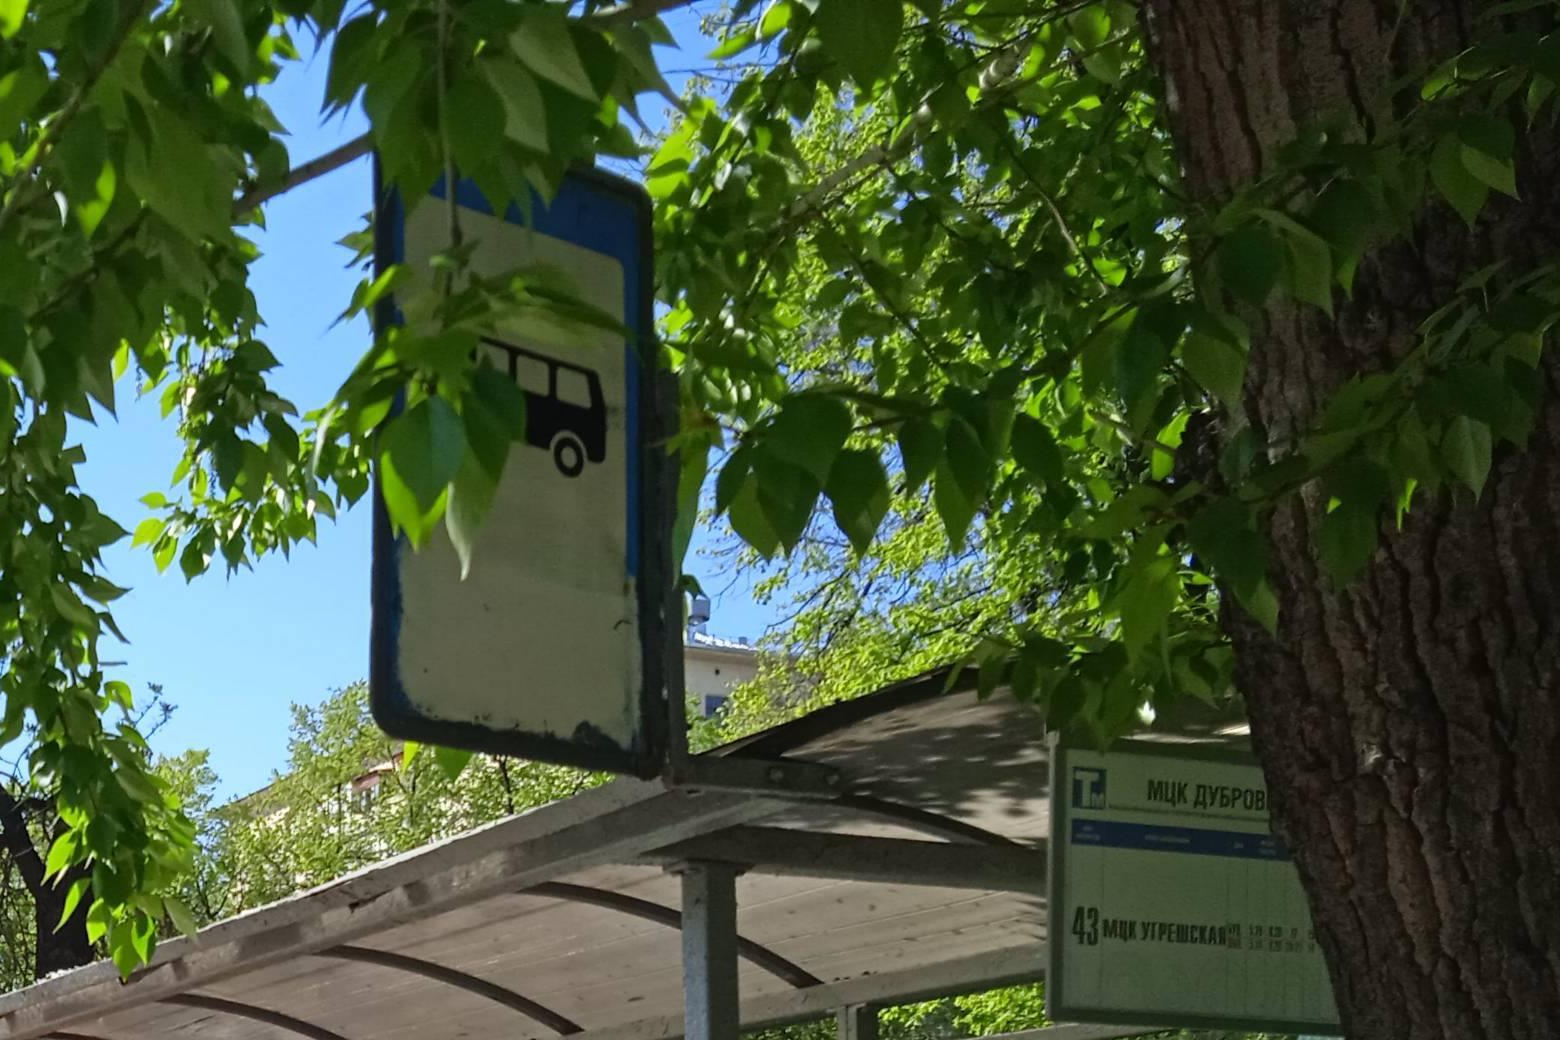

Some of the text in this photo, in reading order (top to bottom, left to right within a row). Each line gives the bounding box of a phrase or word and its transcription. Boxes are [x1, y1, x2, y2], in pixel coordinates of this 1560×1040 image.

[1147, 779, 1269, 811] МЦК ДУБРОВ
[1072, 906, 1099, 946] 43
[1102, 919, 1137, 942] МЦК
[1140, 921, 1226, 945] УГРЕШСКАЯ
